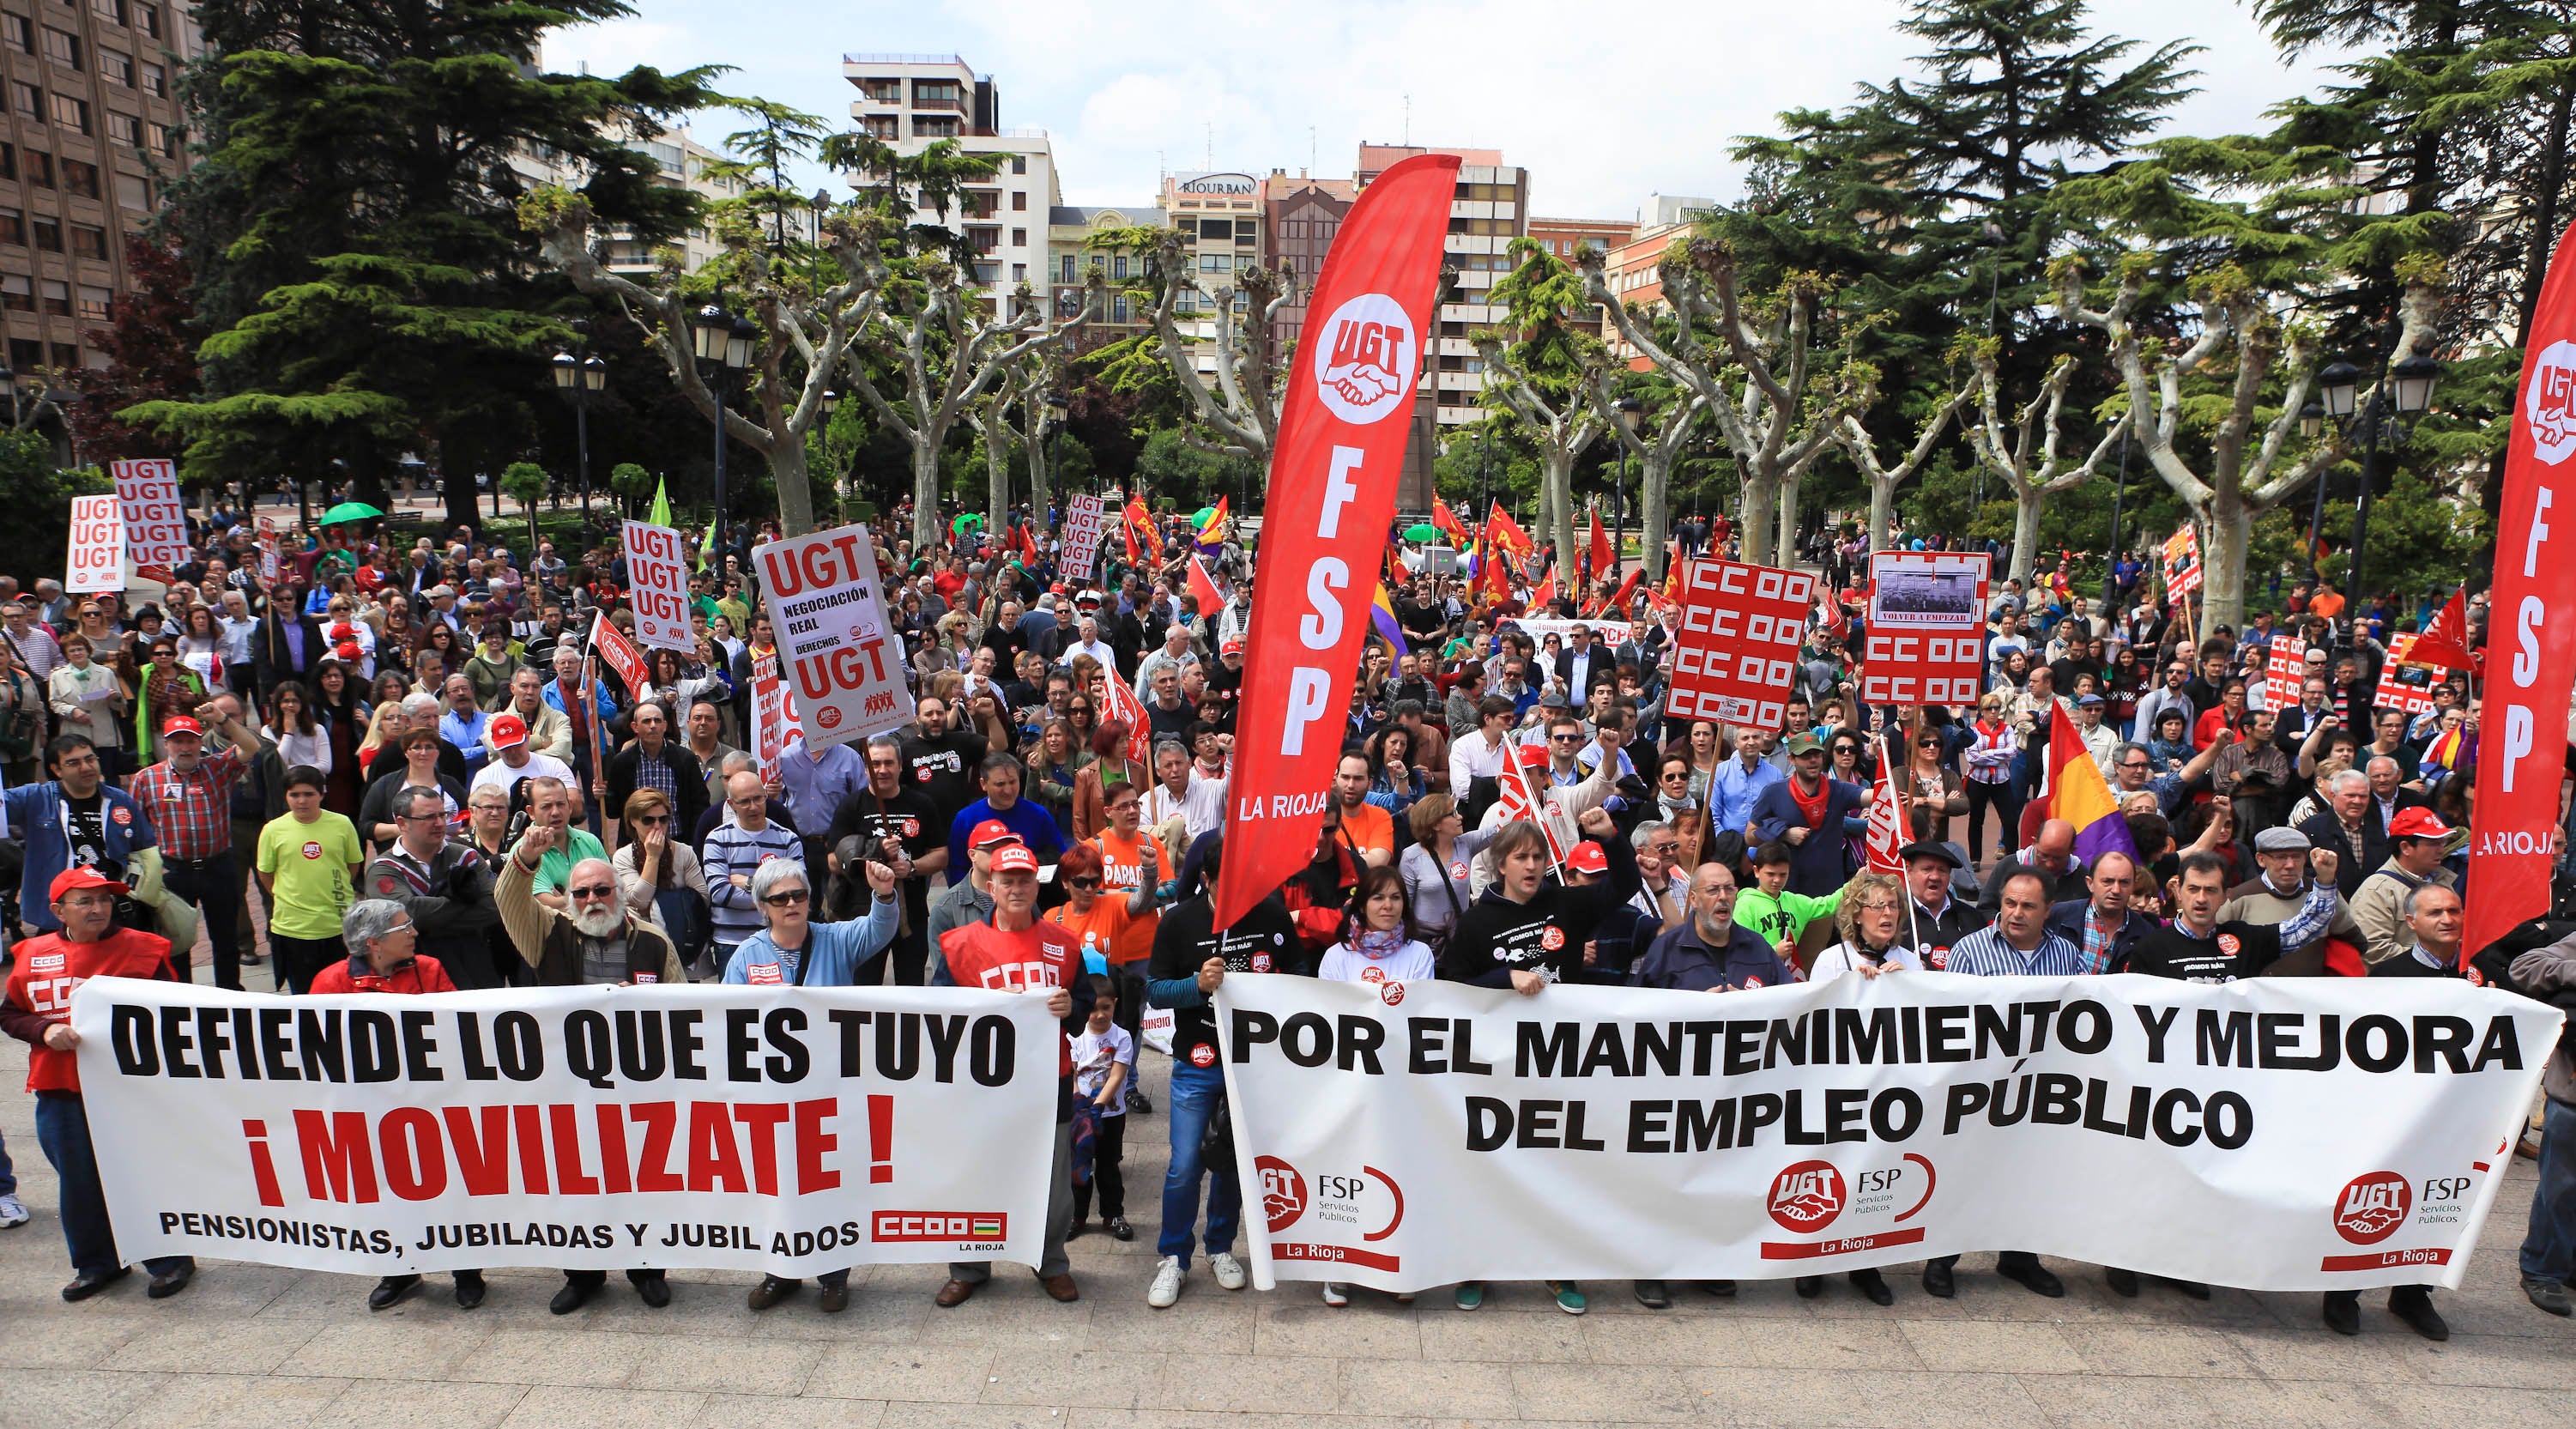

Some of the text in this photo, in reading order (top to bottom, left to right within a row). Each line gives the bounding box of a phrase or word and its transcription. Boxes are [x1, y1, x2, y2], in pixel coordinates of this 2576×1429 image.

[1183, 182, 1251, 194] RIOURBAN
[1331, 319, 1406, 368] UGT
[113, 461, 172, 480] UGT
[118, 482, 175, 501] UGT
[77, 498, 118, 521] UGT
[123, 503, 179, 523] UGT
[1073, 494, 1104, 513] UGT
[1068, 512, 1100, 530] UGT
[76, 522, 120, 545] UGT
[128, 524, 183, 543] UGT
[628, 525, 674, 561] UGT
[1066, 528, 1098, 545] UGT
[74, 546, 119, 569] UGT
[131, 544, 187, 564] UGT
[1062, 544, 1094, 562] UGT
[632, 558, 679, 592] UGT
[764, 535, 860, 598] UGT
[1060, 560, 1091, 578] UGT
[637, 590, 683, 623] UGT
[783, 586, 869, 618] NEGOCIACIÓN
[788, 617, 819, 636] REAL
[1926, 614, 1967, 622] EMPEZAR
[795, 636, 841, 655] DERECHOS
[795, 639, 886, 700] UGT
[1239, 790, 1327, 821] LA RIOJA
[304, 844, 320, 852] UGT
[1001, 848, 1030, 862] CCOO
[1104, 864, 1143, 886] PARAD
[1450, 863, 1464, 874] UGT
[1760, 911, 1797, 934] NYPD
[1508, 930, 1534, 944] ¡SOMOS
[1043, 944, 1062, 955] CCOO
[1932, 949, 1950, 960] UGT
[33, 956, 63, 966] CCOO
[1254, 954, 1270, 966] UGT
[752, 967, 778, 976] CCOO
[979, 961, 1060, 989] CCOO
[1364, 968, 1381, 978] UGT
[1382, 983, 1400, 996] UGT
[1141, 1016, 1170, 1030] DIGNID
[112, 1005, 1016, 1090] DEFIENDE LO QUE ES TUYO
[1232, 999, 2525, 1078] POR EL MANTENIMIENTO Y MEJORA
[1194, 1045, 1212, 1058] UGT
[1466, 1058, 2254, 1153] DEL EMPLEO PÚBLICO
[293, 1097, 842, 1205] MOVILIZATE
[1319, 1174, 1364, 1201] FSP
[1780, 1169, 1835, 1201] UGT
[1858, 1168, 1902, 1194] FSP
[2422, 1177, 2472, 1202] FSP
[1855, 1193, 1895, 1206] Servicios
[2349, 1182, 2404, 1211] UGT
[1319, 1200, 1359, 1214] Servicios
[1854, 1202, 1891, 1216] Públicos
[2420, 1203, 2462, 1214] Servicios
[878, 1215, 969, 1237] CCOO
[1319, 1210, 1358, 1225] Públicos
[2418, 1214, 2459, 1225] Públicos
[160, 1211, 404, 1259] PENSIONISTAS,
[416, 1223, 614, 1250] JUBILADAS
[625, 1223, 649, 1247] Y
[1820, 1234, 1874, 1254] La Rioja
[958, 1242, 1006, 1252] LA RIOJA
[1286, 1243, 1345, 1262] La Rioja
[2381, 1249, 2439, 1265] La Rioja
